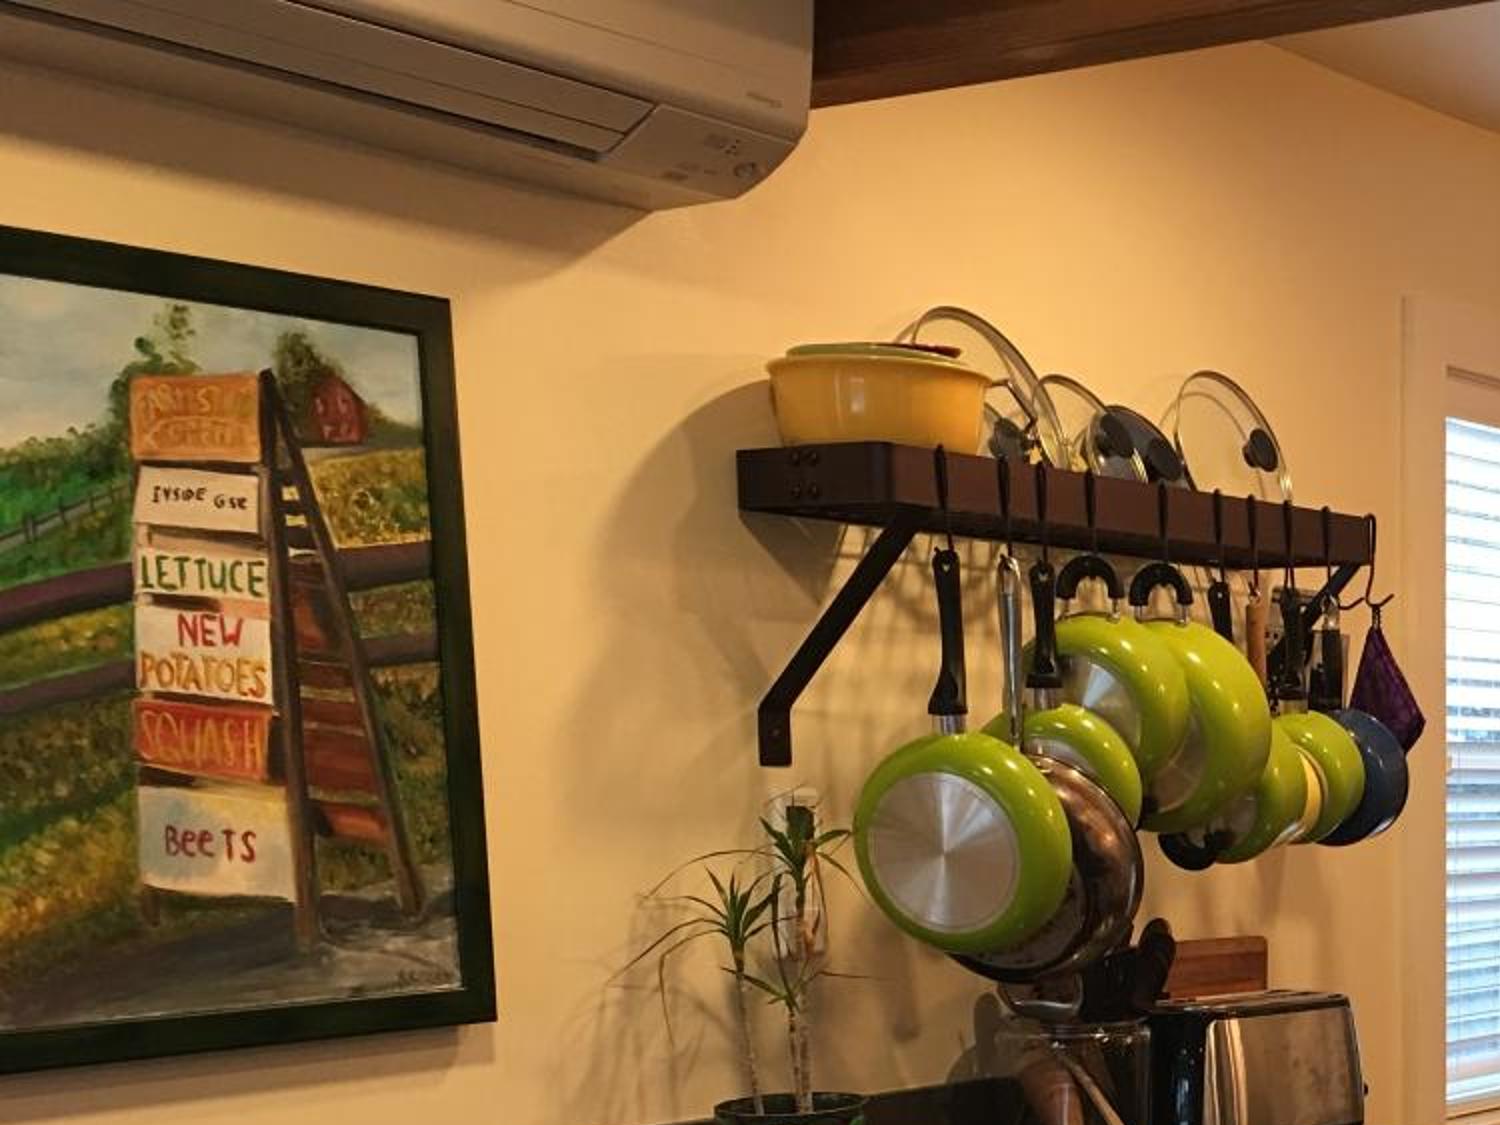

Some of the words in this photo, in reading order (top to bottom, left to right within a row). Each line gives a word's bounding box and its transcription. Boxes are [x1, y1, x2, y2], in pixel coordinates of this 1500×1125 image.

[140, 554, 266, 598] LETTUCE
[177, 612, 244, 647] NEW
[139, 650, 267, 699] POTATOES
[139, 709, 264, 770] SQUASH
